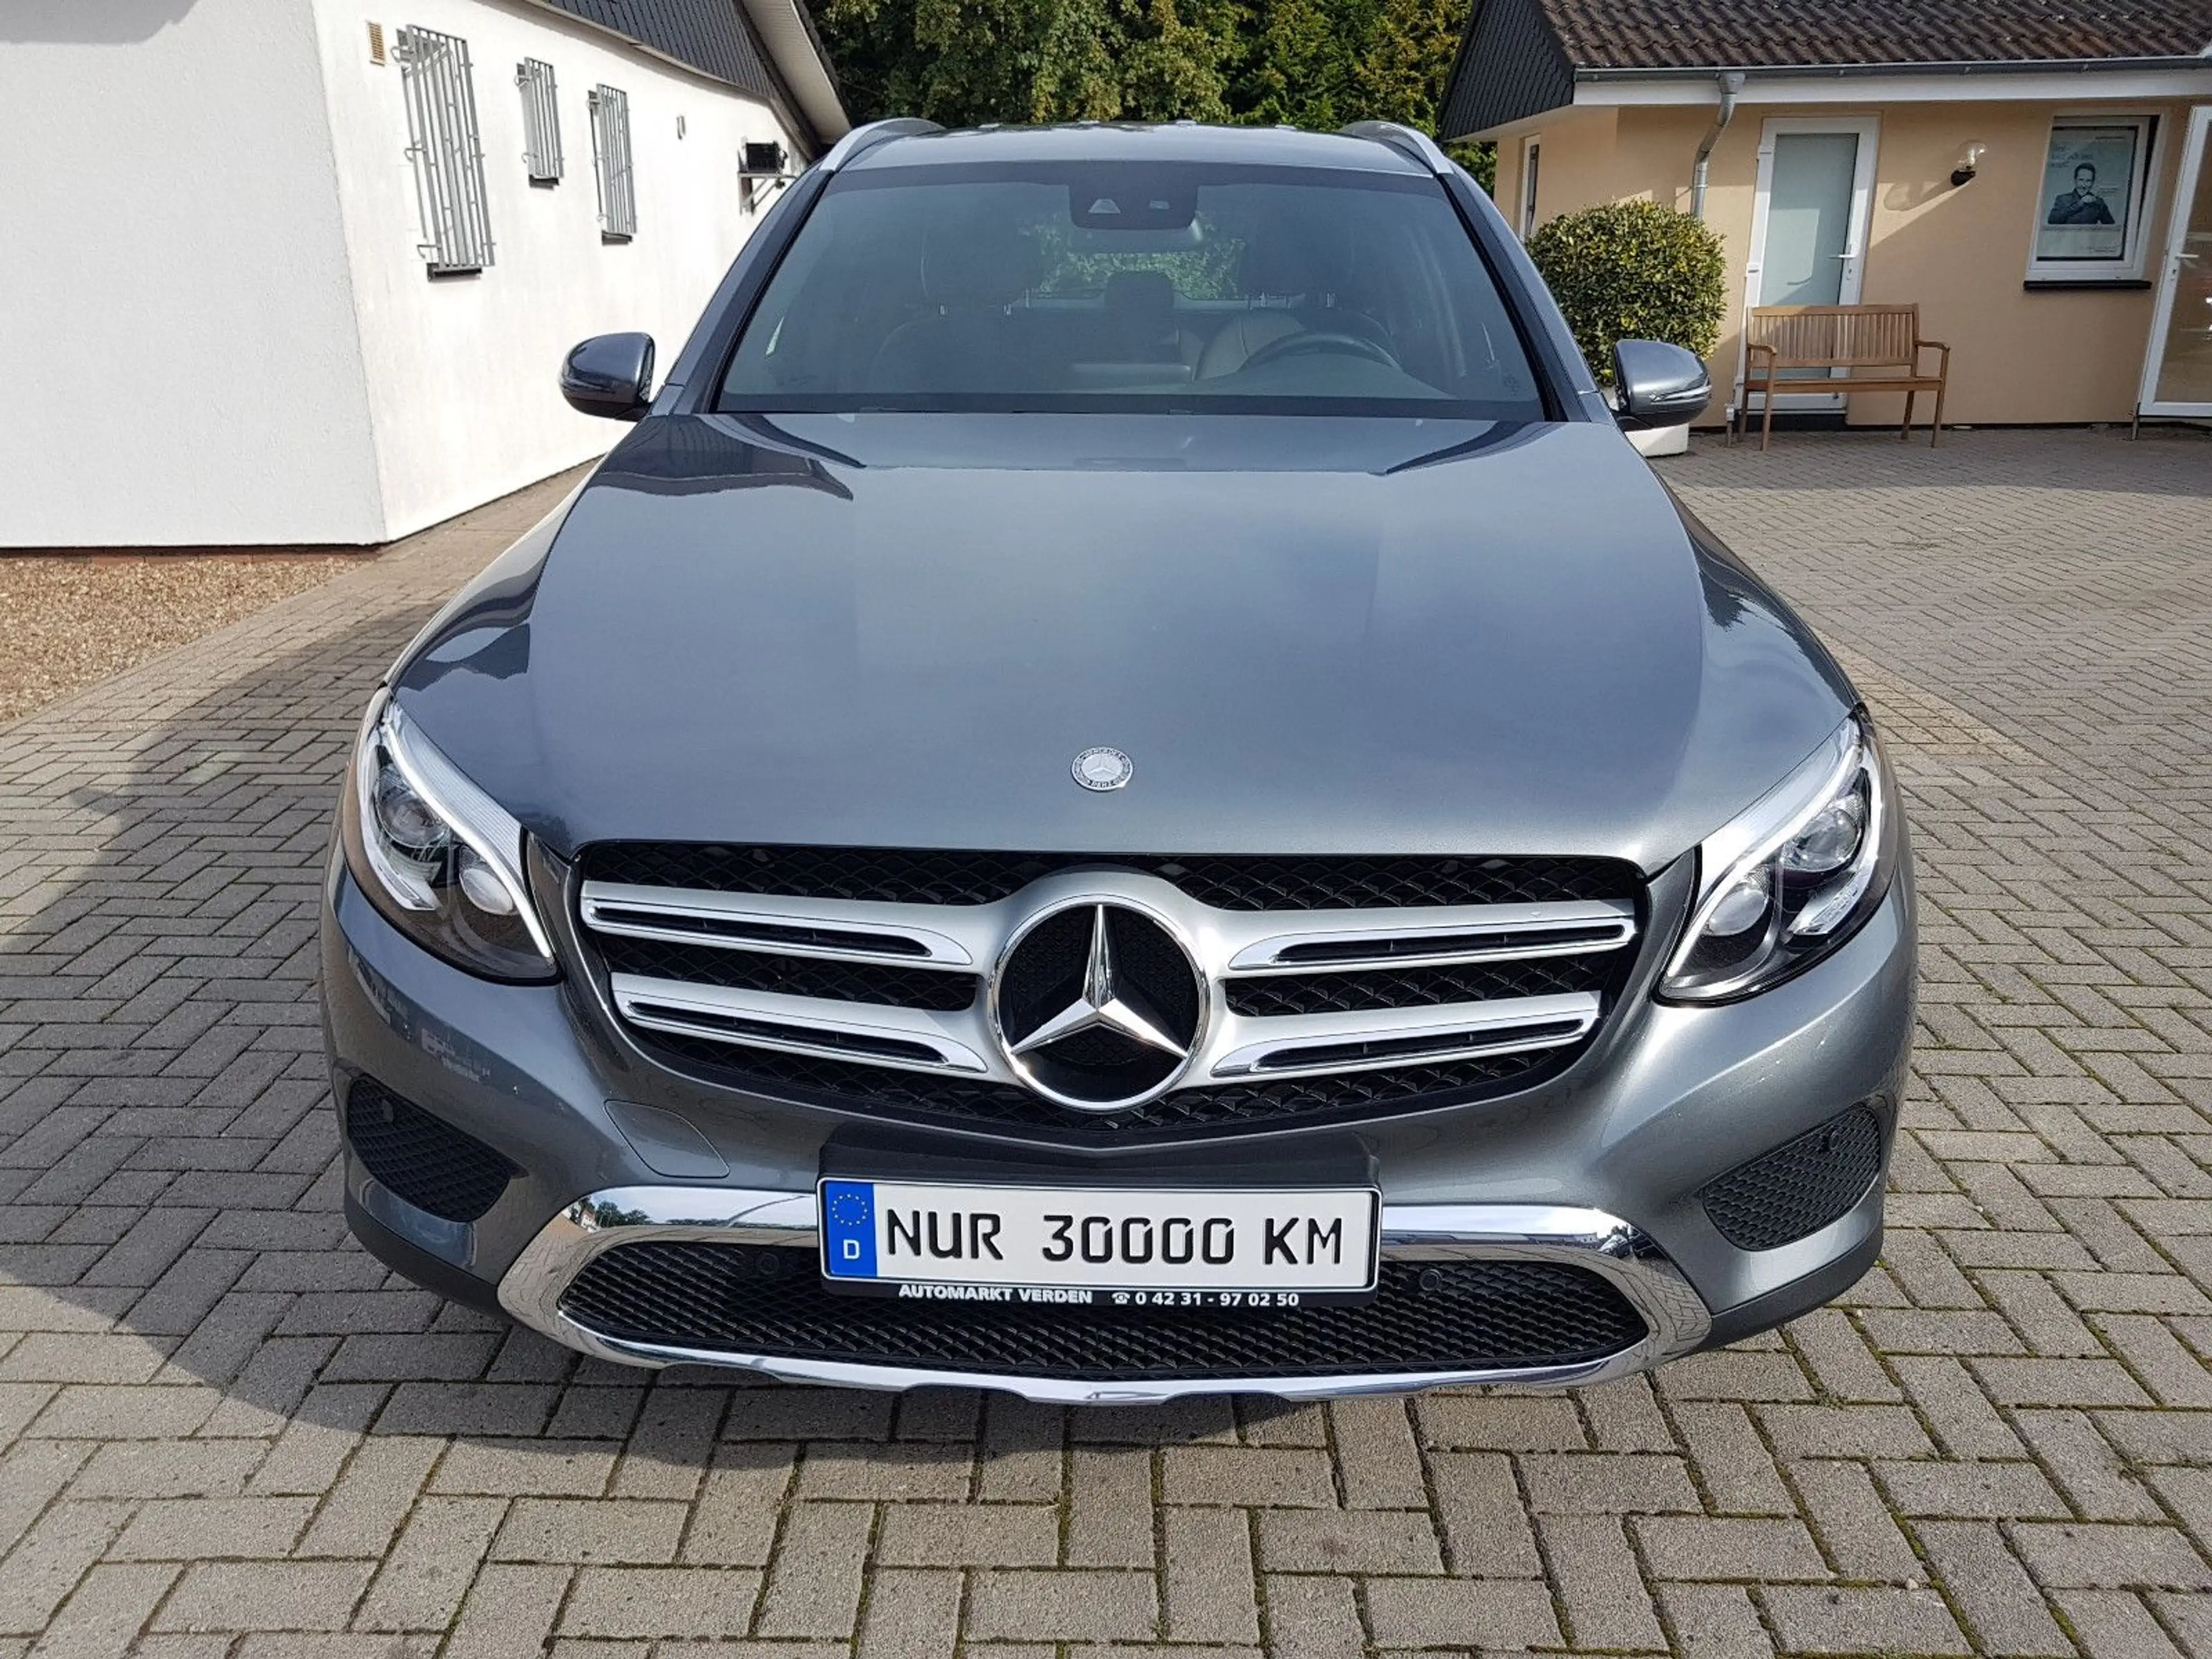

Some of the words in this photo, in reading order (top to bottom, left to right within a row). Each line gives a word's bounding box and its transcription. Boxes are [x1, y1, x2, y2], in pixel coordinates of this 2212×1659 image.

[888, 1209, 1004, 1260] NUR
[1042, 1214, 1234, 1264] 30000
[1265, 1217, 1343, 1265] KM
[843, 1238, 861, 1259] D
[898, 1284, 1013, 1301] AUTOMARKT
[1018, 1288, 1093, 1304] VERDEN
[1135, 1292, 1147, 1305] 0
[1152, 1292, 1175, 1306] 42
[1180, 1293, 1202, 1306] 31
[1219, 1293, 1242, 1306] 97
[1248, 1293, 1271, 1307] 02
[1276, 1294, 1300, 1307] 50
